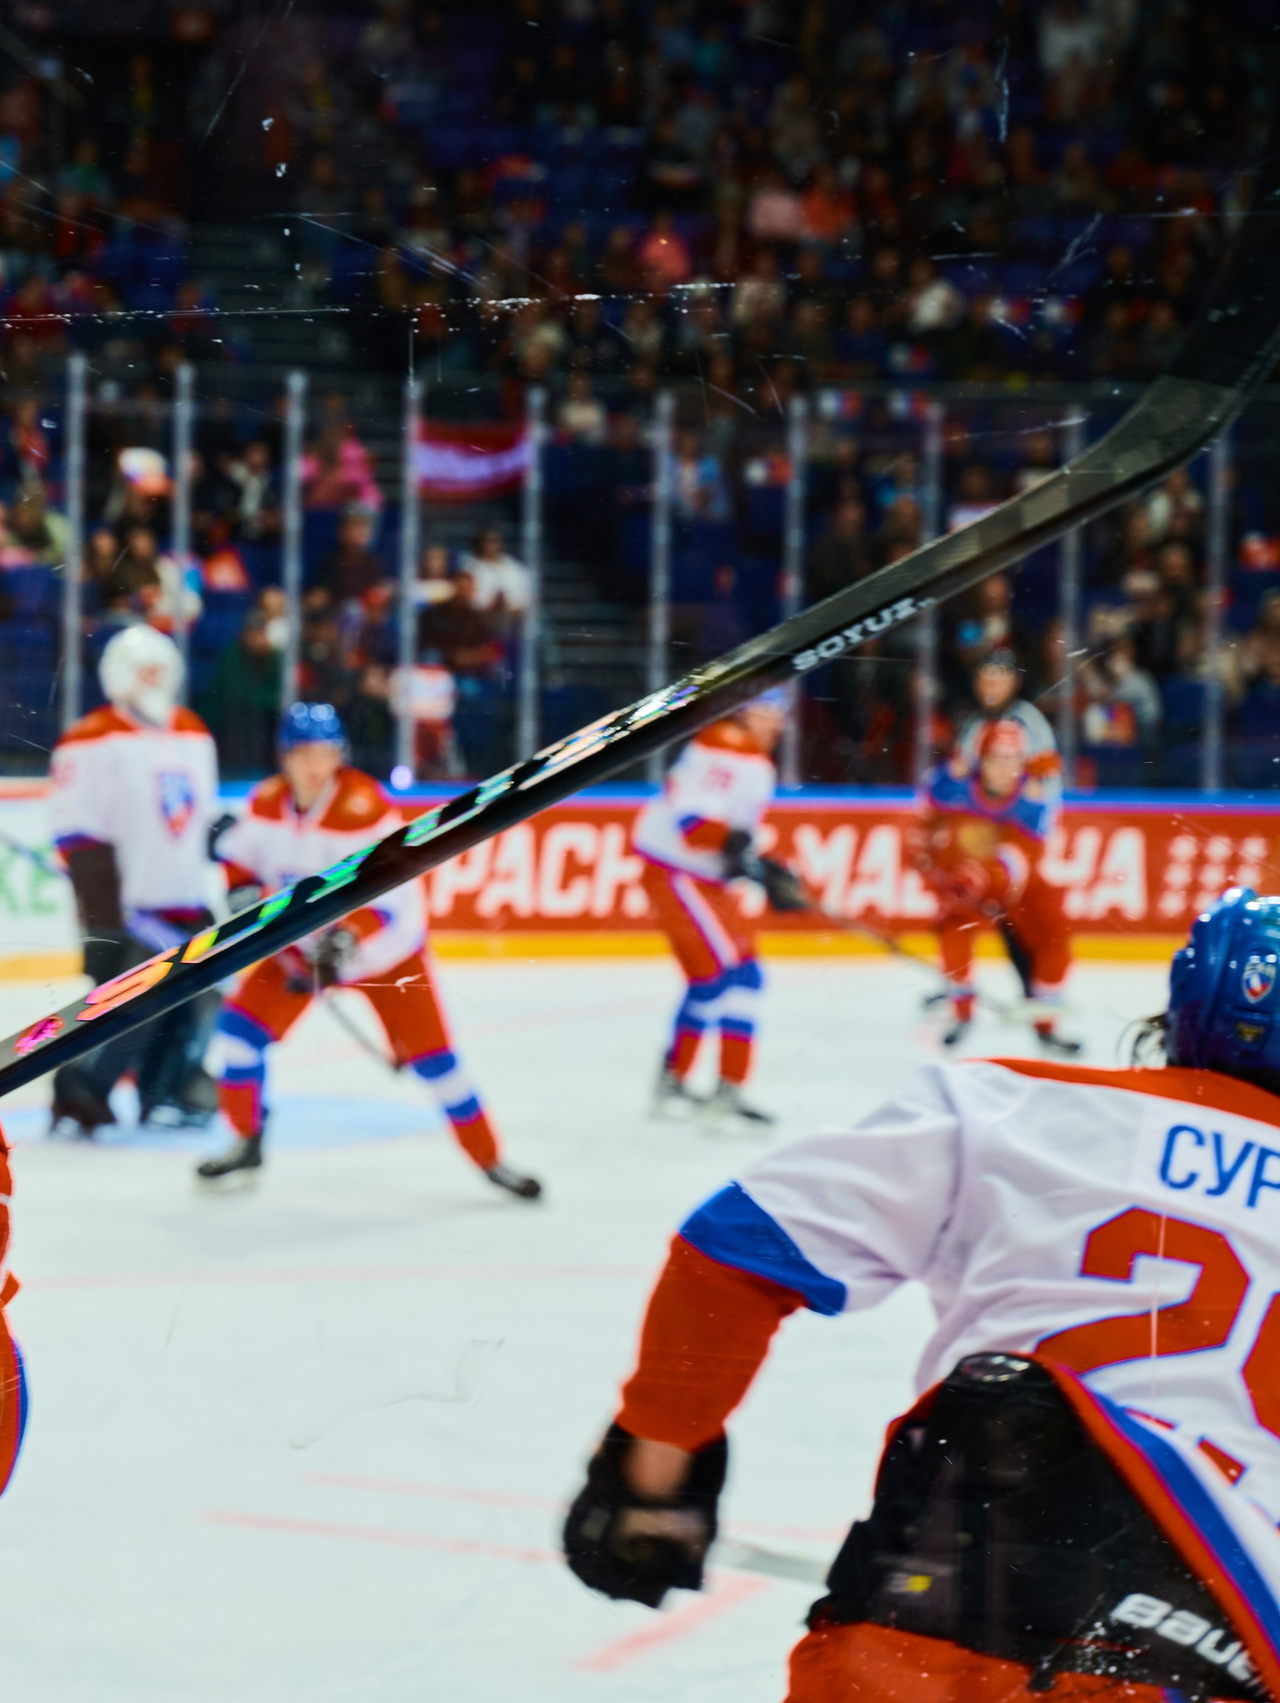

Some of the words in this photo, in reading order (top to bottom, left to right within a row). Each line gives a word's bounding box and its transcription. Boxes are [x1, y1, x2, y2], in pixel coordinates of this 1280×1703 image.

[792, 597, 919, 671] SOYUZ
[428, 821, 778, 919] РАСН
[792, 824, 1148, 920] МАНА
